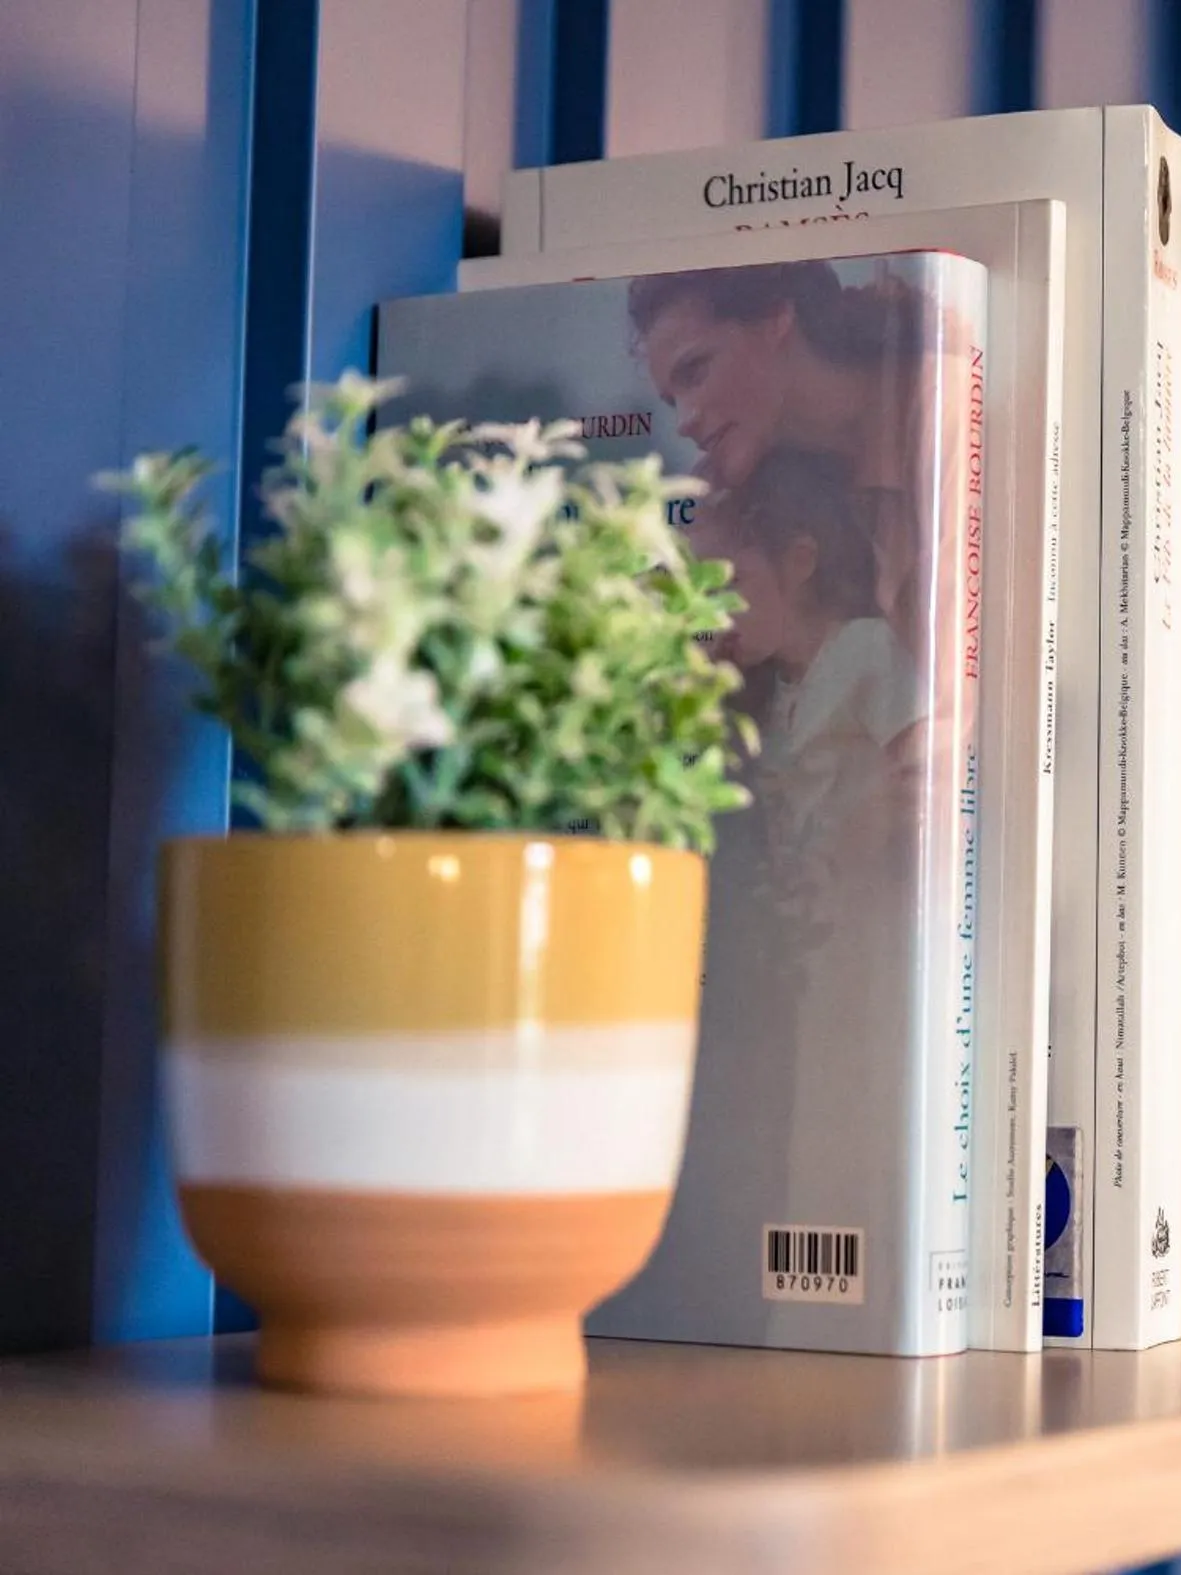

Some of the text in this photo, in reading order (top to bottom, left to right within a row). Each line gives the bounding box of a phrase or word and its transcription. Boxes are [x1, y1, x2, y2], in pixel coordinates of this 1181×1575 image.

[703, 160, 904, 208] Christian Jacq
[580, 411, 653, 440] URDIN
[969, 344, 984, 496] BOURDIN
[1049, 421, 1061, 476] adresse
[1045, 619, 1056, 671] Taylor
[1043, 681, 1054, 775] Kressmann
[961, 742, 976, 815] libre
[958, 828, 974, 941] femme
[954, 1061, 970, 1150] choix
[952, 1162, 968, 1205] Le
[775, 1273, 849, 1294] 870970
[1031, 1203, 1043, 1307] Littératures
